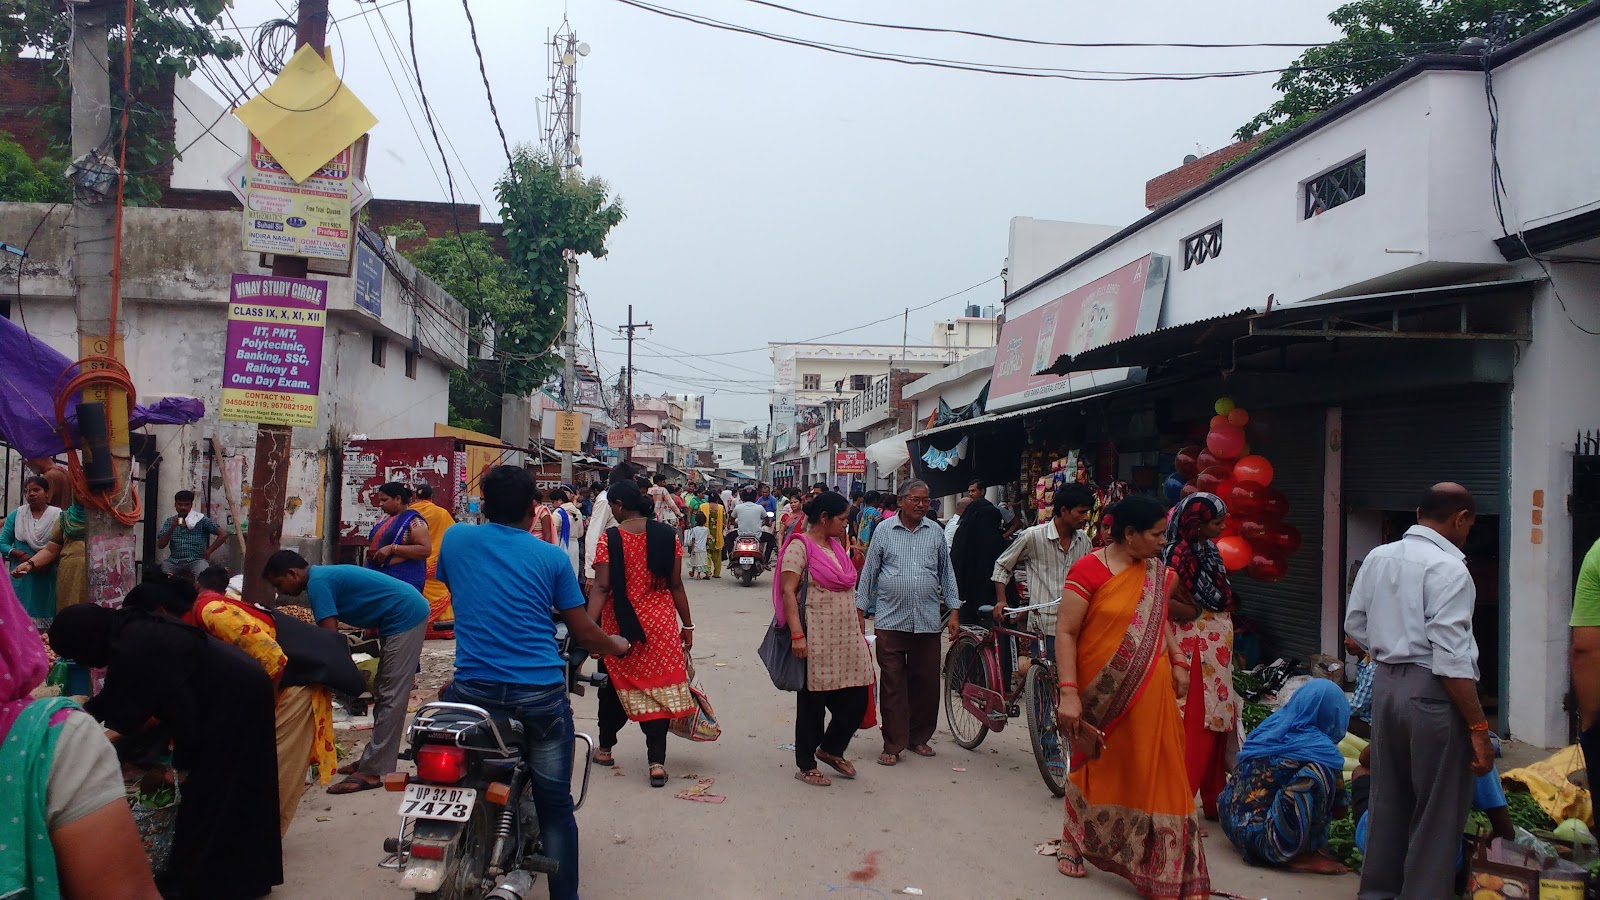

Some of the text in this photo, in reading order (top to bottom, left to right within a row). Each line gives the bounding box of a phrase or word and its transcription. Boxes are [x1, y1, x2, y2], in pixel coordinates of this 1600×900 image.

[266, 200, 286, 208] Session
[249, 211, 282, 221] MATHEMATICS
[326, 207, 341, 215] Classes
[257, 221, 275, 230] Suhail
[275, 223, 284, 231] Sir
[320, 221, 342, 229] PHYSICS
[249, 232, 271, 240] INDIRA
[272, 235, 296, 243] NAGAR
[318, 227, 339, 238] Pradeep
[301, 238, 321, 246] GOMTI
[323, 241, 346, 249] NAGAR
[235, 280, 322, 305] VINAY STUDY CIRCLE
[234, 306, 320, 322] CLASS IX, X, XI, XII
[253, 326, 297, 340] IIT, PMT,
[242, 337, 306, 354] Polytechnic,
[236, 350, 310, 366] Banking, SSC,
[245, 362, 298, 376] Railway &
[232, 374, 311, 389] One Day Exam.
[1054, 381, 1067, 391] STORE
[245, 392, 278, 400] CONTACT
[225, 399, 269, 409] 9450452119,
[416, 787, 463, 803] UP 32 DZ
[404, 800, 468, 817] 7473
